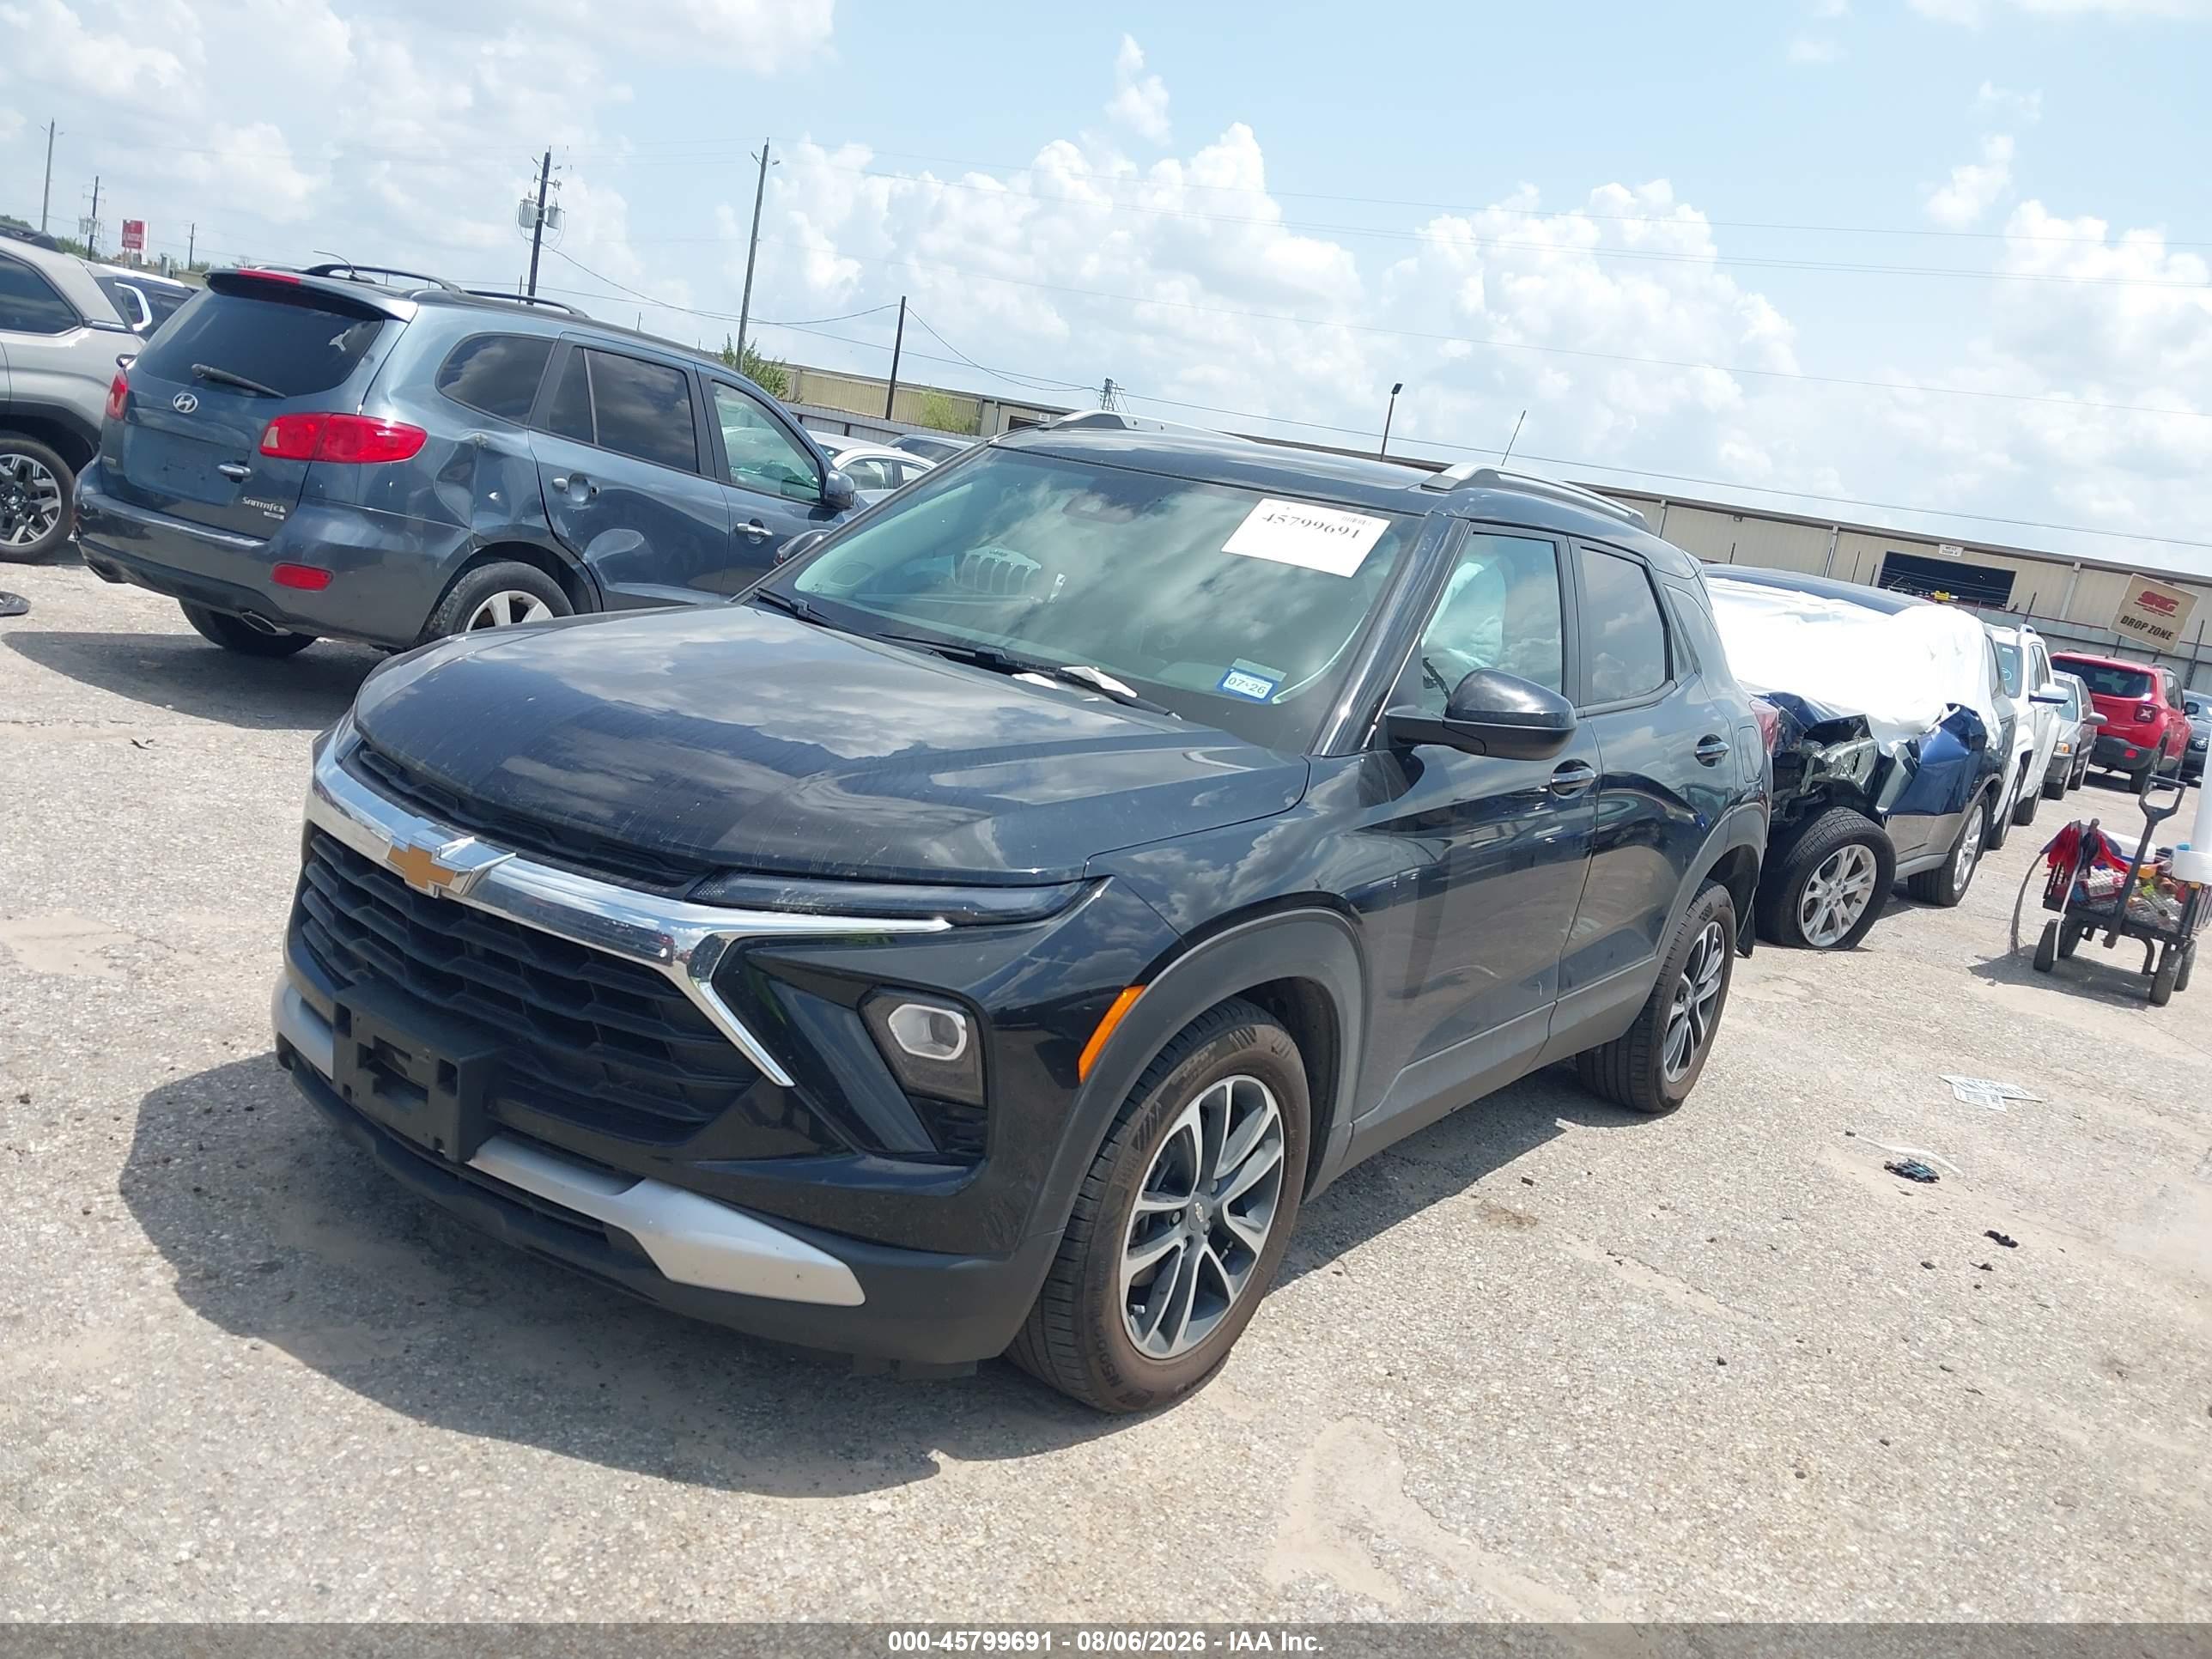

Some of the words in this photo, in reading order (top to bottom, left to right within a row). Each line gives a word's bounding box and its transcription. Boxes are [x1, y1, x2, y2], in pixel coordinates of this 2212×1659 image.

[1261, 514, 1360, 538] 45799691
[2120, 616, 2148, 631] DROP
[2148, 625, 2173, 641] ZONE
